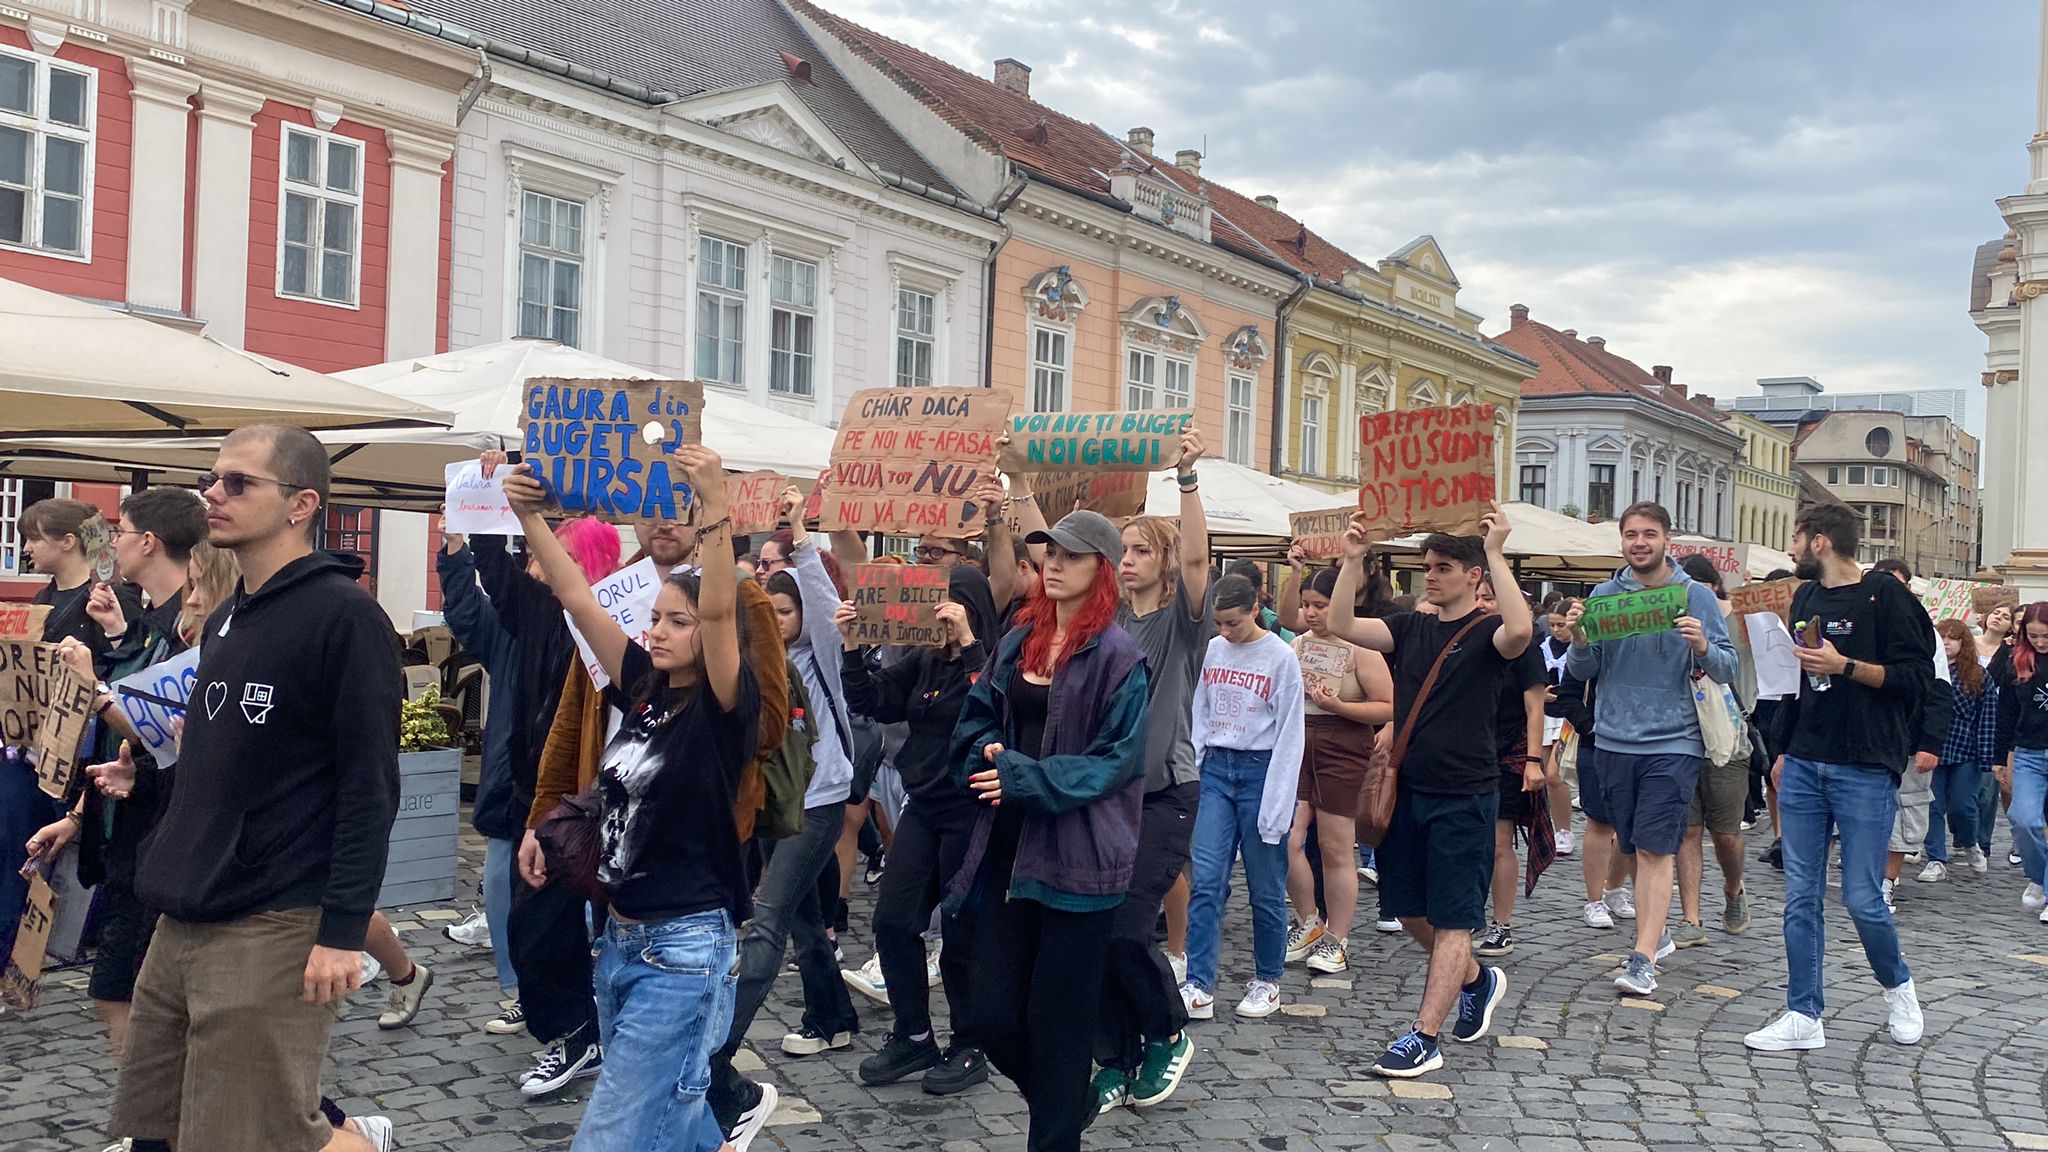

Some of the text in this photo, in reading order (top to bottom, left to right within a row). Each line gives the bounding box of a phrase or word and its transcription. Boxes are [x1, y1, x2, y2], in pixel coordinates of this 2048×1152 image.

[528, 384, 689, 422] GAURA din
[921, 392, 972, 418] DACĂ
[1013, 414, 1048, 434] VOI
[1120, 412, 1193, 436] BUGET
[525, 421, 639, 460] BUGET
[842, 429, 994, 456] PE NOI NE-APASĂ
[1027, 437, 1161, 465] NOI GRIJI
[1373, 429, 1494, 481] NU SUNT
[838, 501, 863, 524] NU
[874, 499, 895, 523] VĂ
[905, 501, 950, 529] PASĂ
[855, 587, 947, 606] ARE BILET
[847, 616, 943, 644] FĂRĂ ÎNTORS
[1215, 688, 1243, 718] 86
